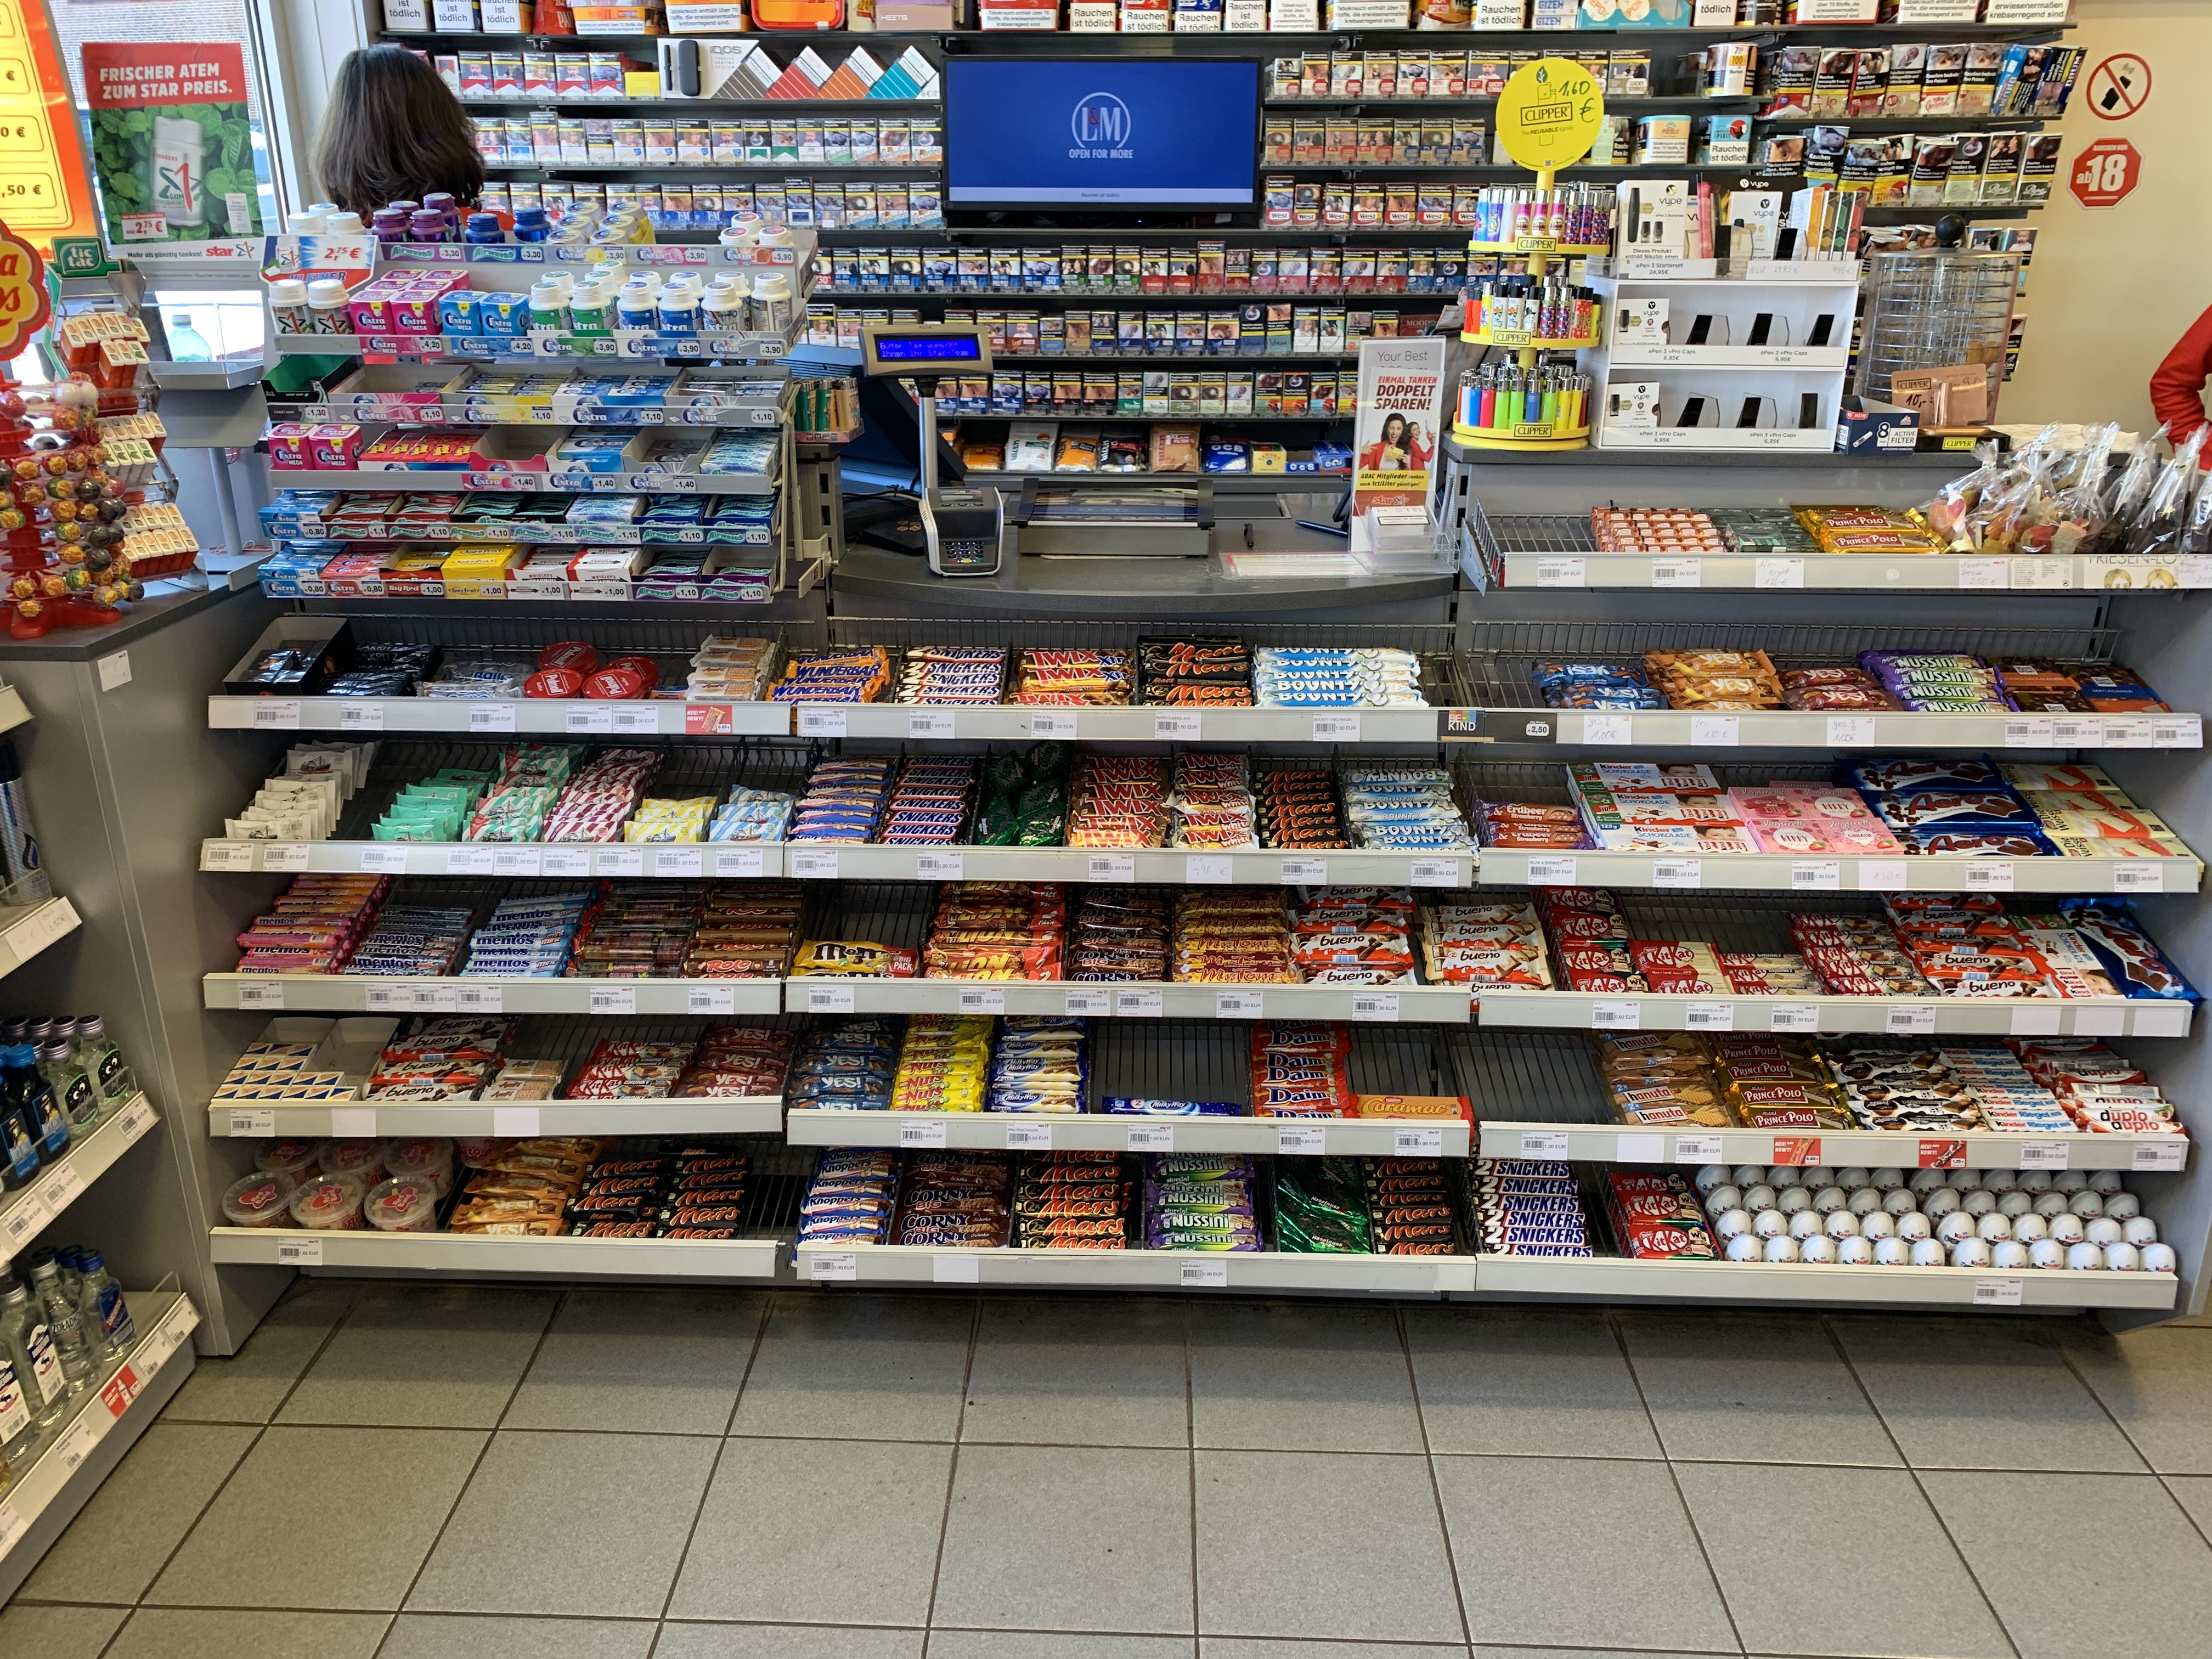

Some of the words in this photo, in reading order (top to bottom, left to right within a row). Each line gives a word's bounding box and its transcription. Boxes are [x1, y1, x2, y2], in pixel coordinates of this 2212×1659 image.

[1481, 5, 1521, 14] Rauchen
[1538, 1, 1564, 9] GIZEH
[1701, 4, 1731, 13] tödlich
[1085, 19, 1114, 27] tödlich
[1478, 15, 1491, 24] ist
[1492, 15, 1522, 24] tödlich
[1536, 16, 1561, 25] GIZEH
[99, 65, 175, 82] FRISCHER
[179, 63, 219, 78] ATEM
[2065, 56, 2081, 87] DRUM
[103, 84, 137, 100] ZUM
[140, 83, 179, 97] STAR
[183, 80, 233, 95] PREIS.
[1525, 106, 1568, 121] CLIPPER
[1579, 97, 1596, 123] €
[1081, 107, 1121, 142] L&M
[1069, 149, 1090, 159] OPEN
[1092, 149, 1108, 159] FOR
[1110, 149, 1133, 159] MORE
[1712, 145, 1747, 153] Rauchen
[1722, 154, 1747, 162] tödlich
[2076, 173, 2092, 185] ab
[2086, 154, 2127, 192] 18
[1659, 196, 1682, 206] vype
[1270, 211, 1289, 220] West
[155, 221, 162, 234] €
[1520, 240, 1553, 249] CLIPPER
[72, 245, 92, 257] tic
[127, 250, 143, 259] Mehr
[154, 251, 178, 260] günstig
[179, 250, 202, 258] tanken!
[206, 246, 234, 257] star
[391, 245, 435, 260] Airwaves
[558, 248, 586, 260] Extra
[67, 255, 94, 268] tac
[361, 314, 385, 325] Extra
[1497, 332, 1528, 343] CLIPPER
[1378, 351, 1403, 362] Your
[1405, 351, 1428, 361] Best
[1899, 380, 1929, 389] CLIPPER
[1376, 385, 1435, 397] DOPPELT
[1374, 398, 1431, 410] SPAREN!
[1518, 426, 1550, 436] CLIPPER
[1878, 422, 1890, 438] 8
[1373, 495, 1393, 505] star
[330, 525, 368, 538] Airwaves
[1024, 650, 1097, 667] TWIX
[1703, 652, 1742, 664] YES!
[795, 664, 882, 678] WUNDERBAR
[926, 661, 1003, 674] SNICKERS
[1277, 680, 1363, 692] BOUNTY
[1713, 678, 1752, 691] YES!
[922, 685, 1000, 697] SNICKERS
[1167, 685, 1252, 701] Mars
[1448, 721, 1476, 732] KIND
[1265, 802, 1335, 817] Mars
[1506, 805, 1547, 817] Erdbeer
[1905, 794, 1985, 816] Aero
[1510, 812, 1543, 821] Strawberry
[1221, 822, 1248, 830] white
[1762, 820, 1807, 828] Yogurette
[958, 908, 1023, 922] LION
[1318, 910, 1363, 920] bueno
[893, 962, 912, 971] PACK
[417, 1036, 460, 1046] bueno
[1272, 1030, 1328, 1046] Daim
[904, 1087, 943, 1100] Nuts
[1745, 1090, 1775, 1102] PRINCE
[1777, 1088, 1801, 1099] POLO
[1361, 1098, 1448, 1116] Caramac
[1641, 1108, 1686, 1123] hanuta
[1989, 1110, 2018, 1119] kinder
[2019, 1109, 2050, 1120] Riegel
[2100, 1108, 2147, 1123] duplo
[905, 1188, 970, 1207] CORNY
